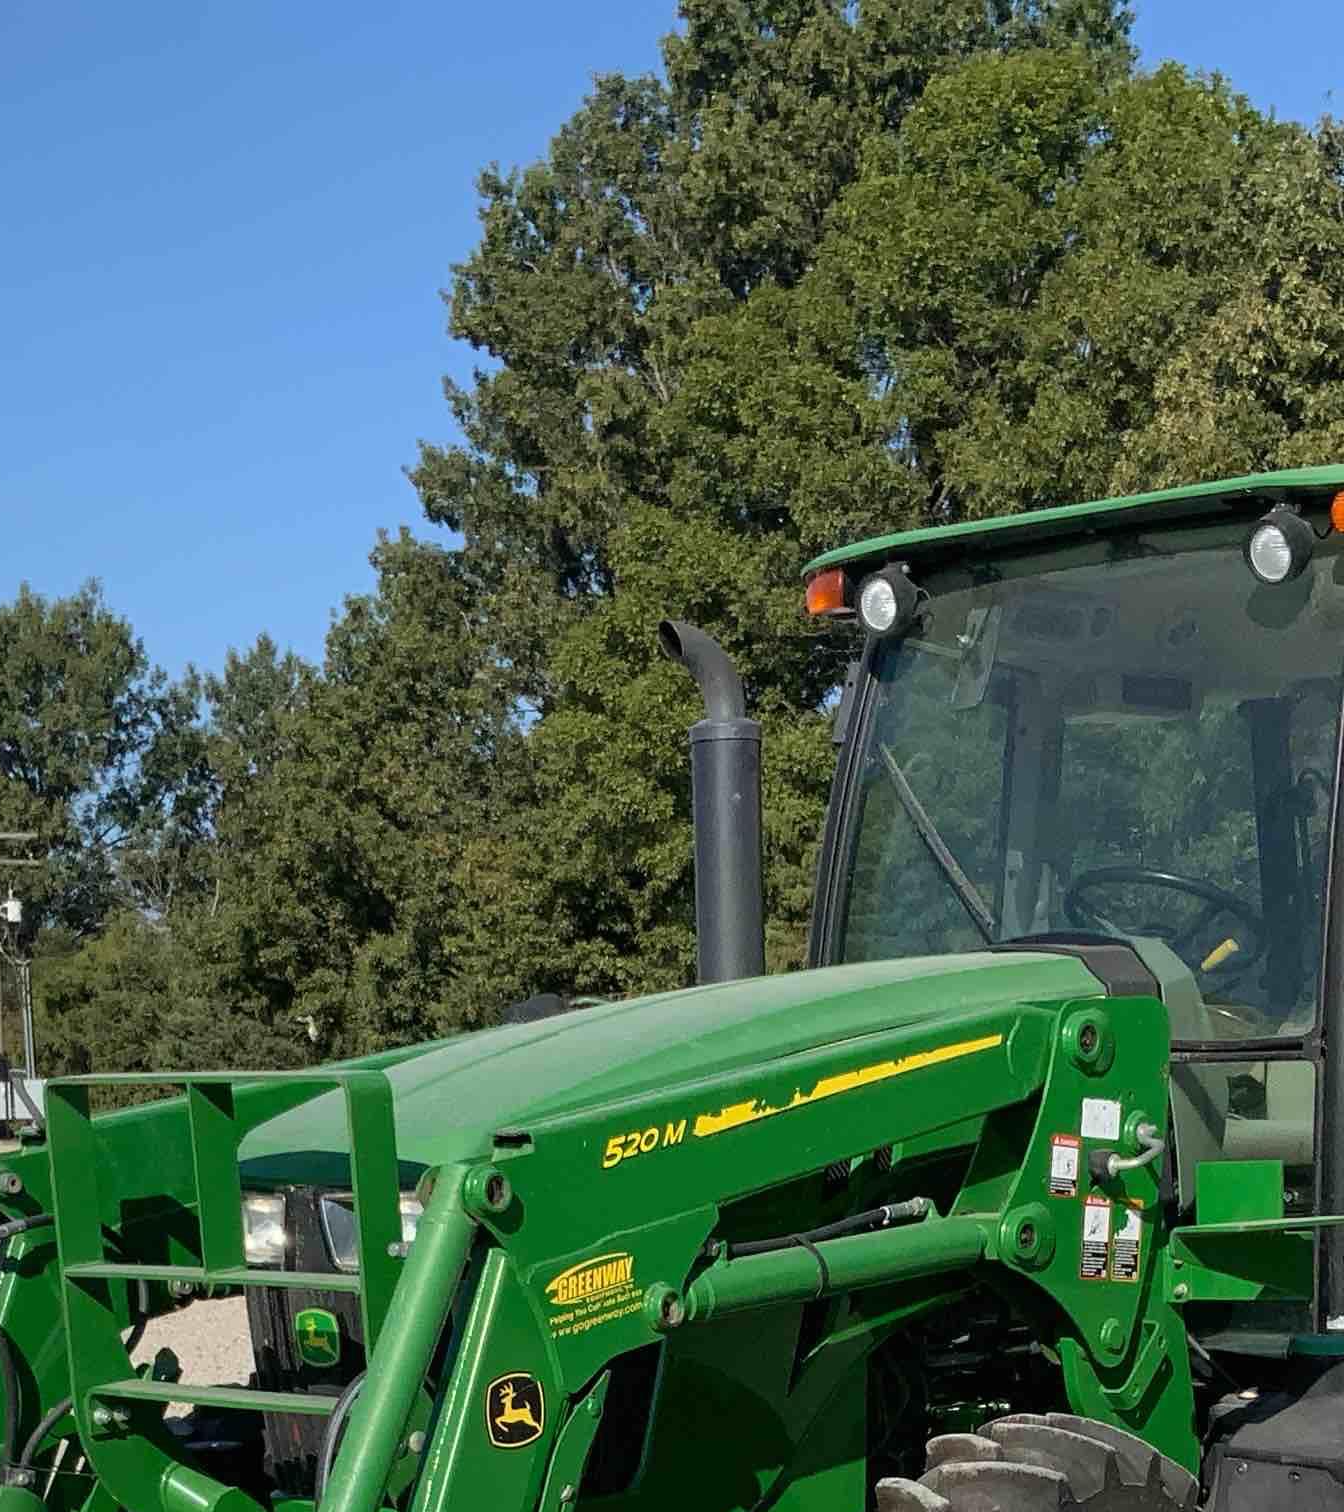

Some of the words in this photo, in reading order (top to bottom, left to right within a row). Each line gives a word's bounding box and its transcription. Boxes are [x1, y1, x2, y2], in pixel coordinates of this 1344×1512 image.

[602, 1127, 659, 1169] 520
[663, 1119, 687, 1147] M
[558, 1256, 634, 1302] GREENWAY
